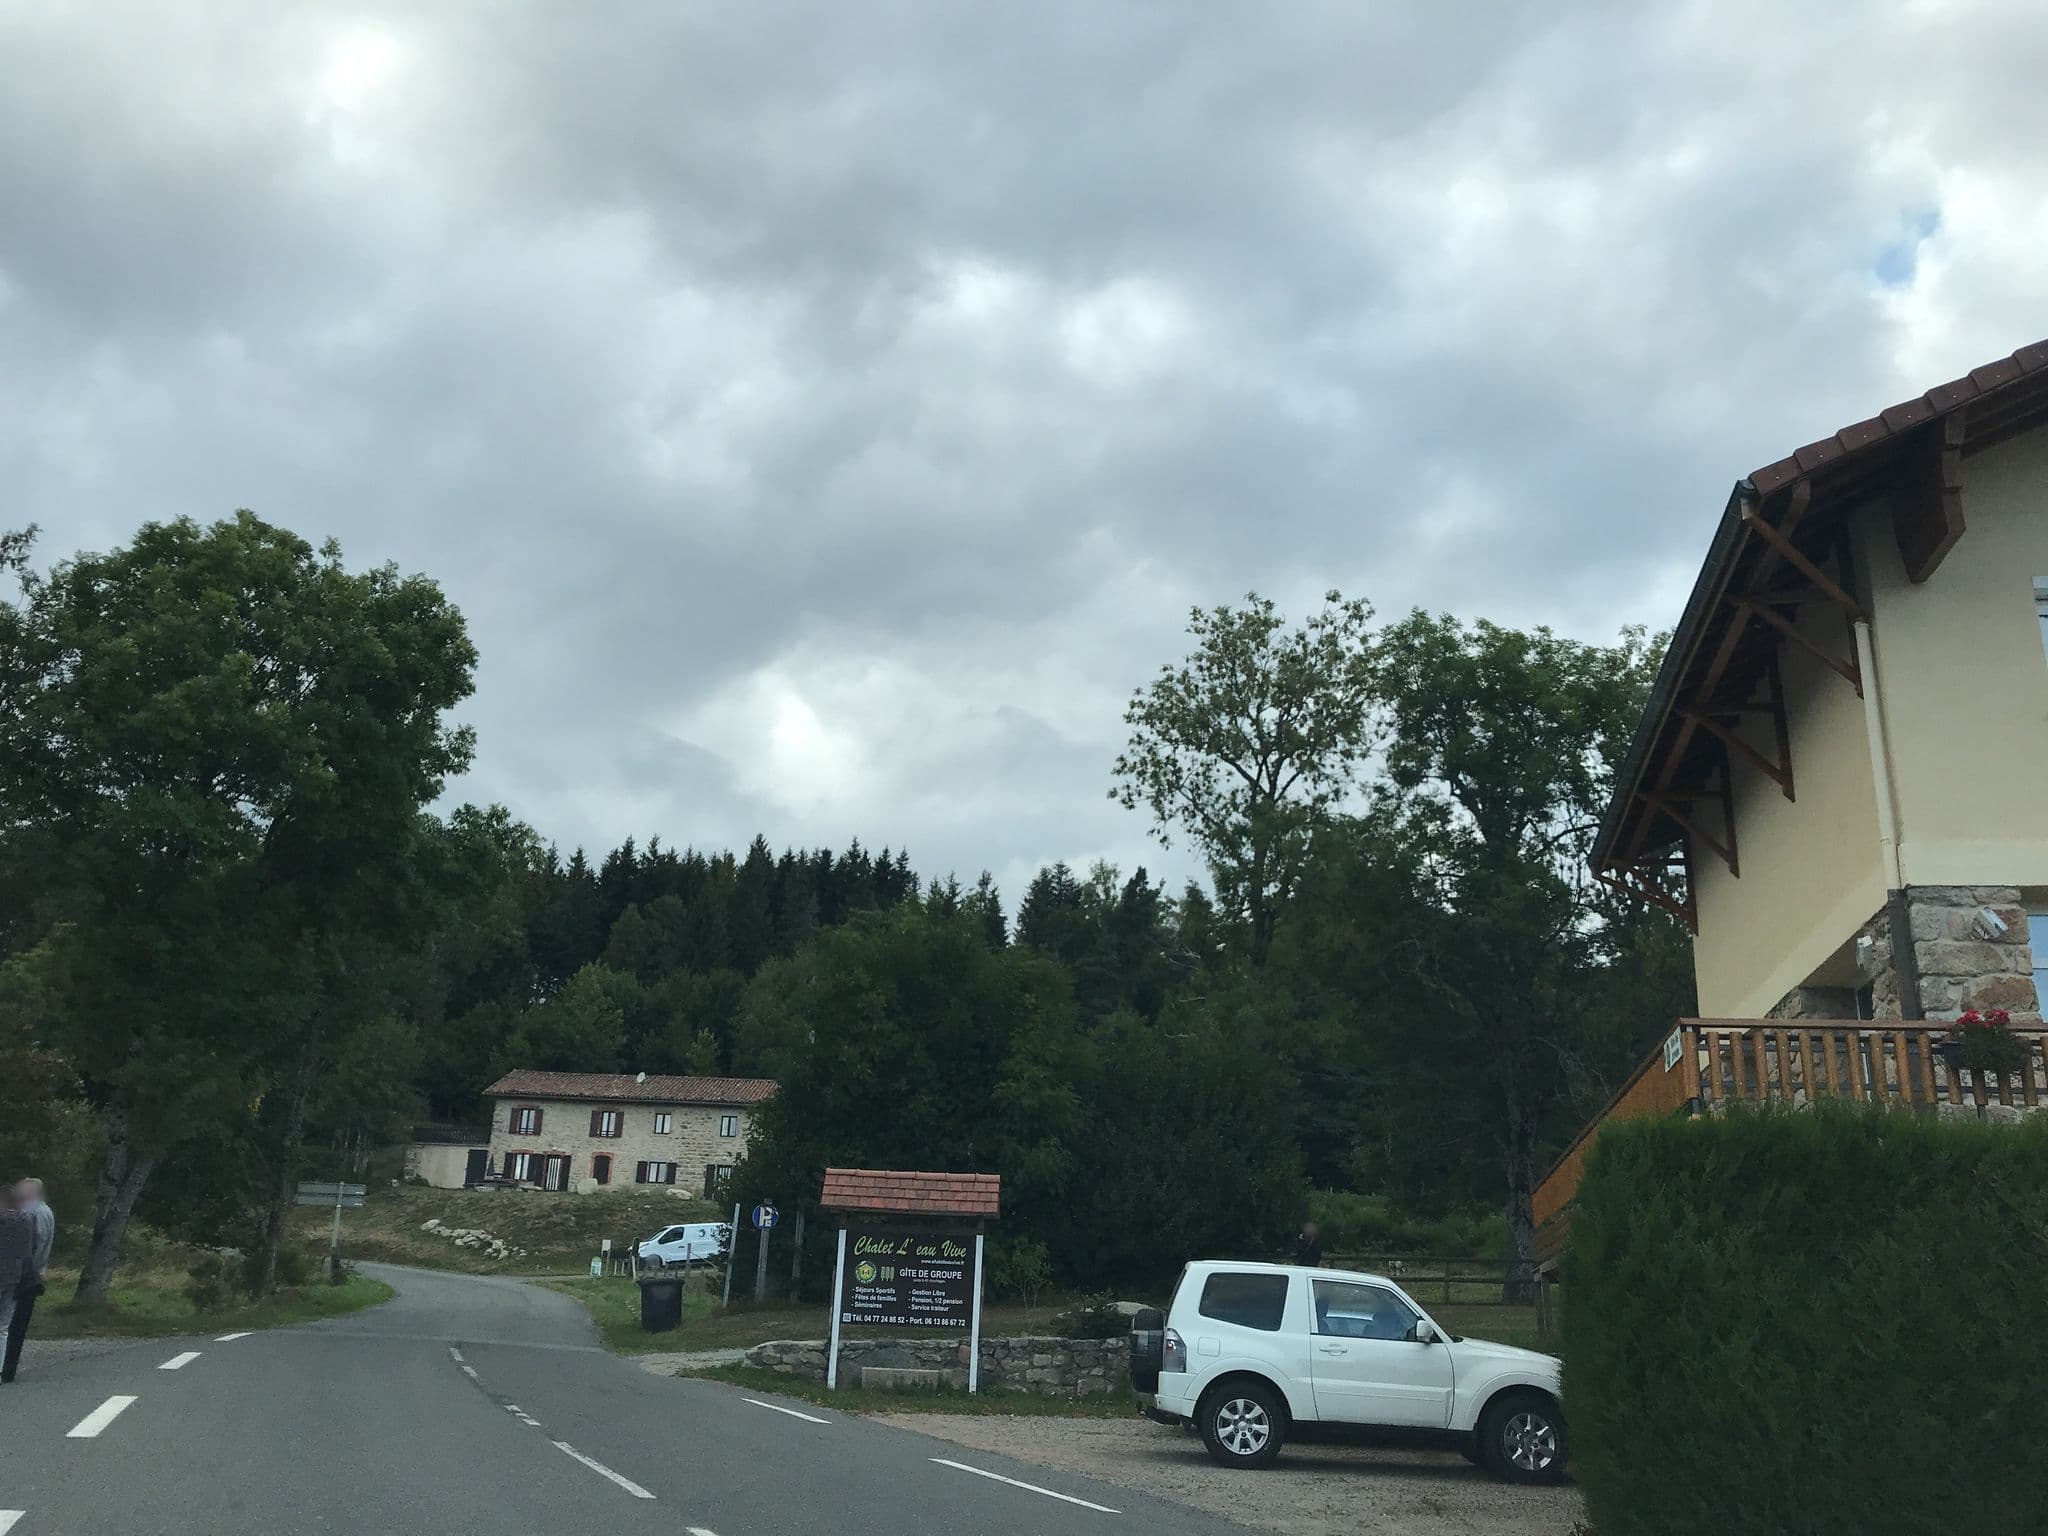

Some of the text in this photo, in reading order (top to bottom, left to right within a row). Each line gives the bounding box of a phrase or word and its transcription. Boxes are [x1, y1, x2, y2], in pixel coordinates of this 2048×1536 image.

[854, 1235, 894, 1255] Chalet
[916, 1245, 937, 1256] eau
[941, 1240, 967, 1257] Vive
[918, 1269, 929, 1278] DE
[930, 1270, 962, 1280] GROUPE
[855, 1286, 895, 1295] Séjours Sportifs
[912, 1288, 946, 1297] Gestion Libre
[877, 1294, 897, 1302] familles
[854, 1301, 883, 1309] Séminaires
[930, 1304, 949, 1312] traiteur
[864, 1314, 871, 1322] 04
[872, 1315, 880, 1323] 77
[881, 1315, 888, 1323] 24
[897, 1316, 905, 1324] 52
[958, 1319, 966, 1327] 72
